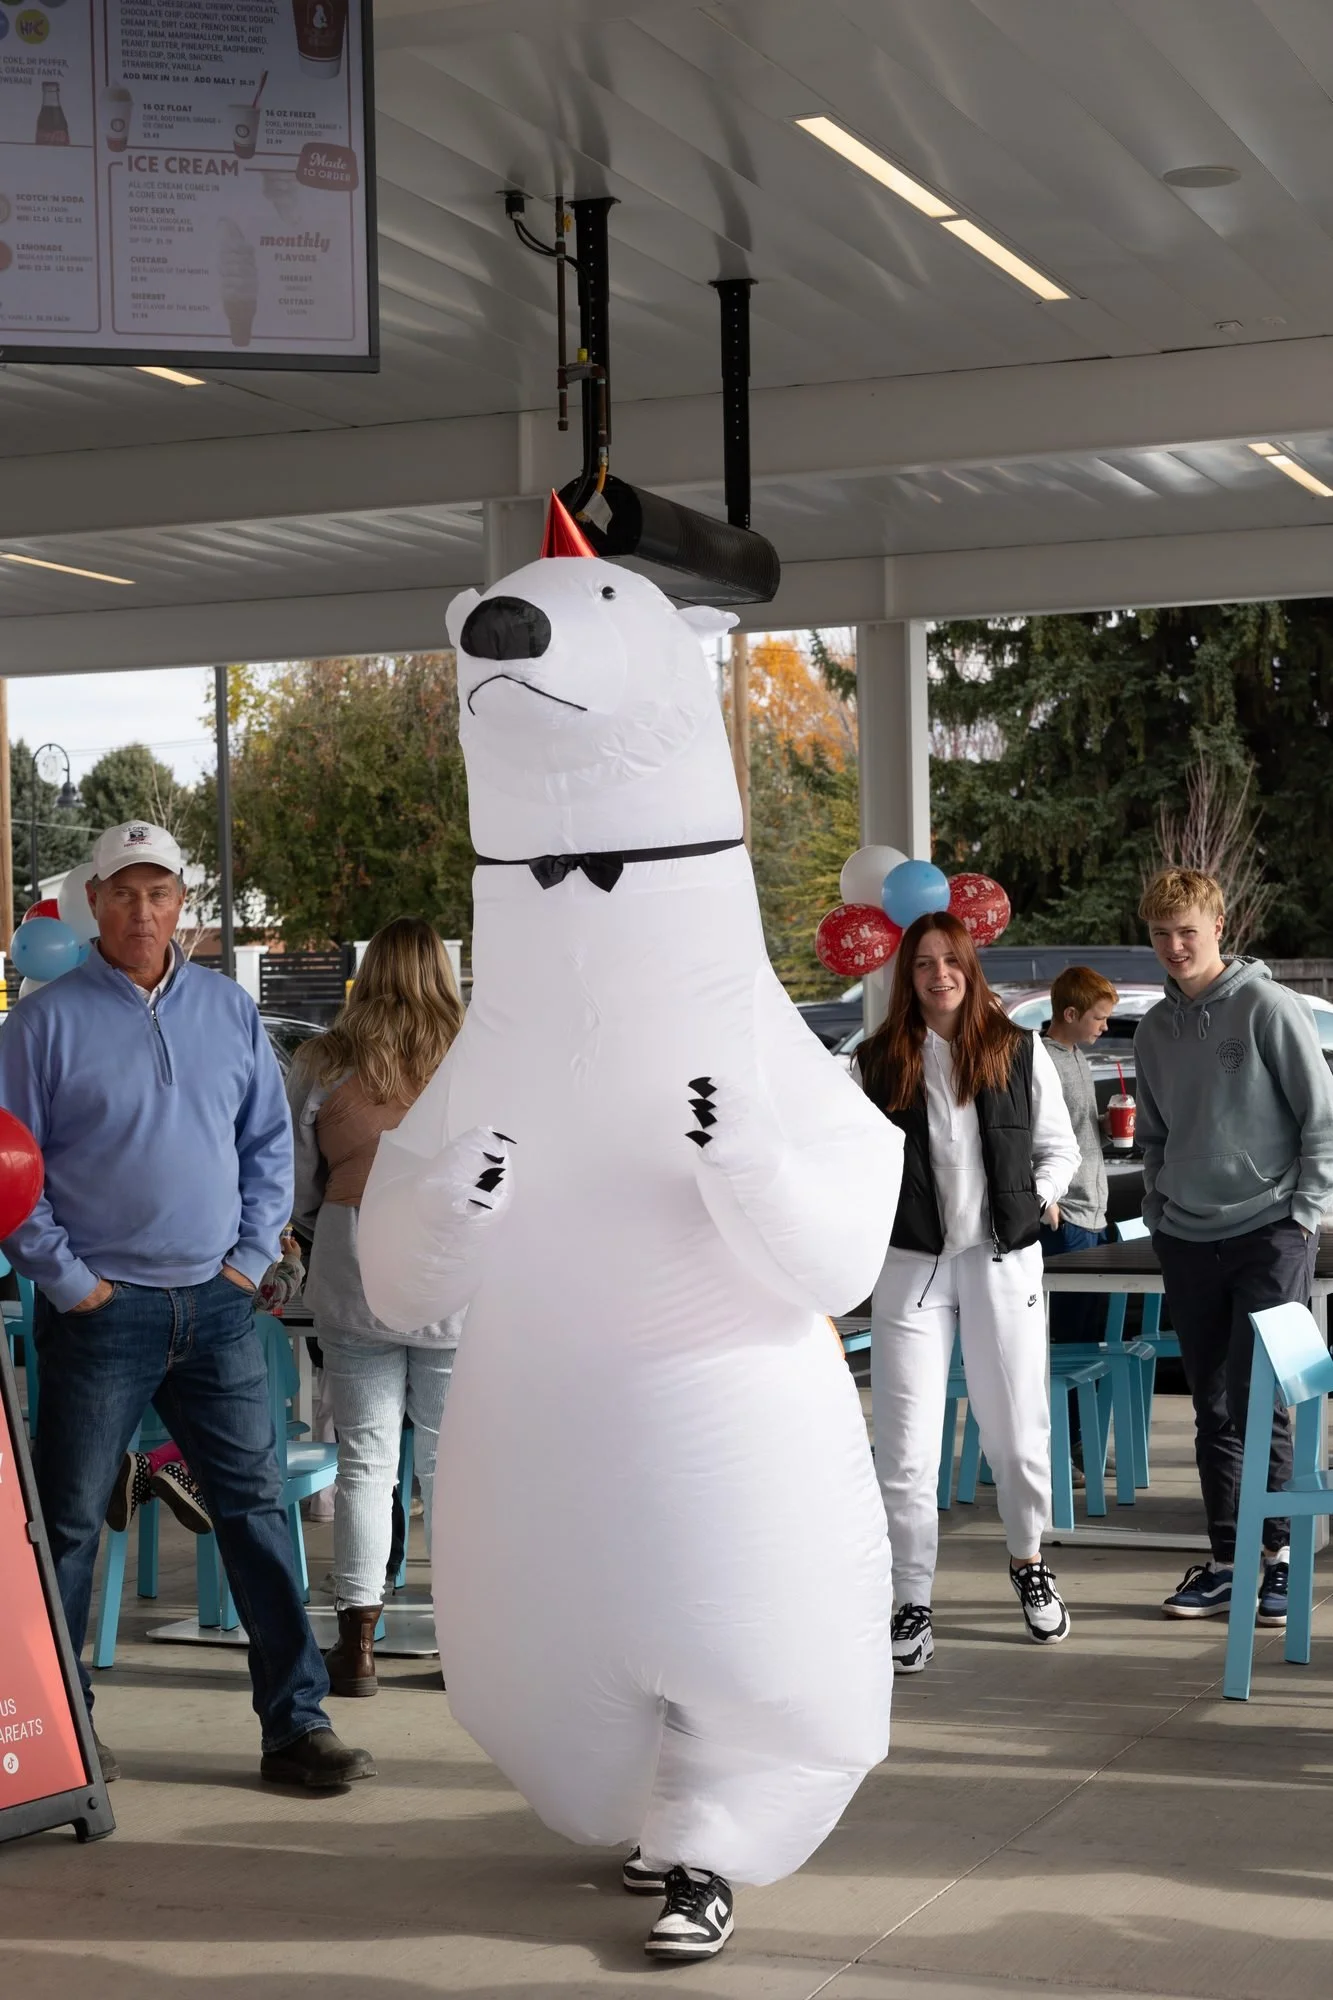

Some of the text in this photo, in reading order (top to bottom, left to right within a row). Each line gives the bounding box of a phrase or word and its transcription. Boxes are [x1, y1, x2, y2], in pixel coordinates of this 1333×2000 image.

[121, 8, 161, 17] CHOCOLATE
[185, 12, 220, 20] COCONUT,
[206, 3, 235, 12] CHERRY,
[237, 5, 279, 15] CHOCOLATE,
[121, 19, 145, 27] CREAM
[201, 23, 228, 31] FRENCH
[122, 39, 149, 47] PEANUT
[172, 63, 201, 71] VANILLA
[167, 105, 193, 113] FLOAT
[266, 109, 274, 117] 16
[289, 111, 316, 119] FREEZE
[127, 155, 239, 177] ICE CREAM
[309, 153, 347, 170] Made
[304, 168, 350, 181] TO ORDER
[129, 181, 141, 189] ALL
[157, 182, 182, 190] CREAM
[16, 193, 48, 201] SCOTCH
[129, 206, 176, 215] SOFT SERVE
[260, 232, 331, 252] monthly
[16, 244, 63, 252] LEMONADE
[274, 253, 317, 262] FLAVORS
[0, 1698, 16, 1716] US
